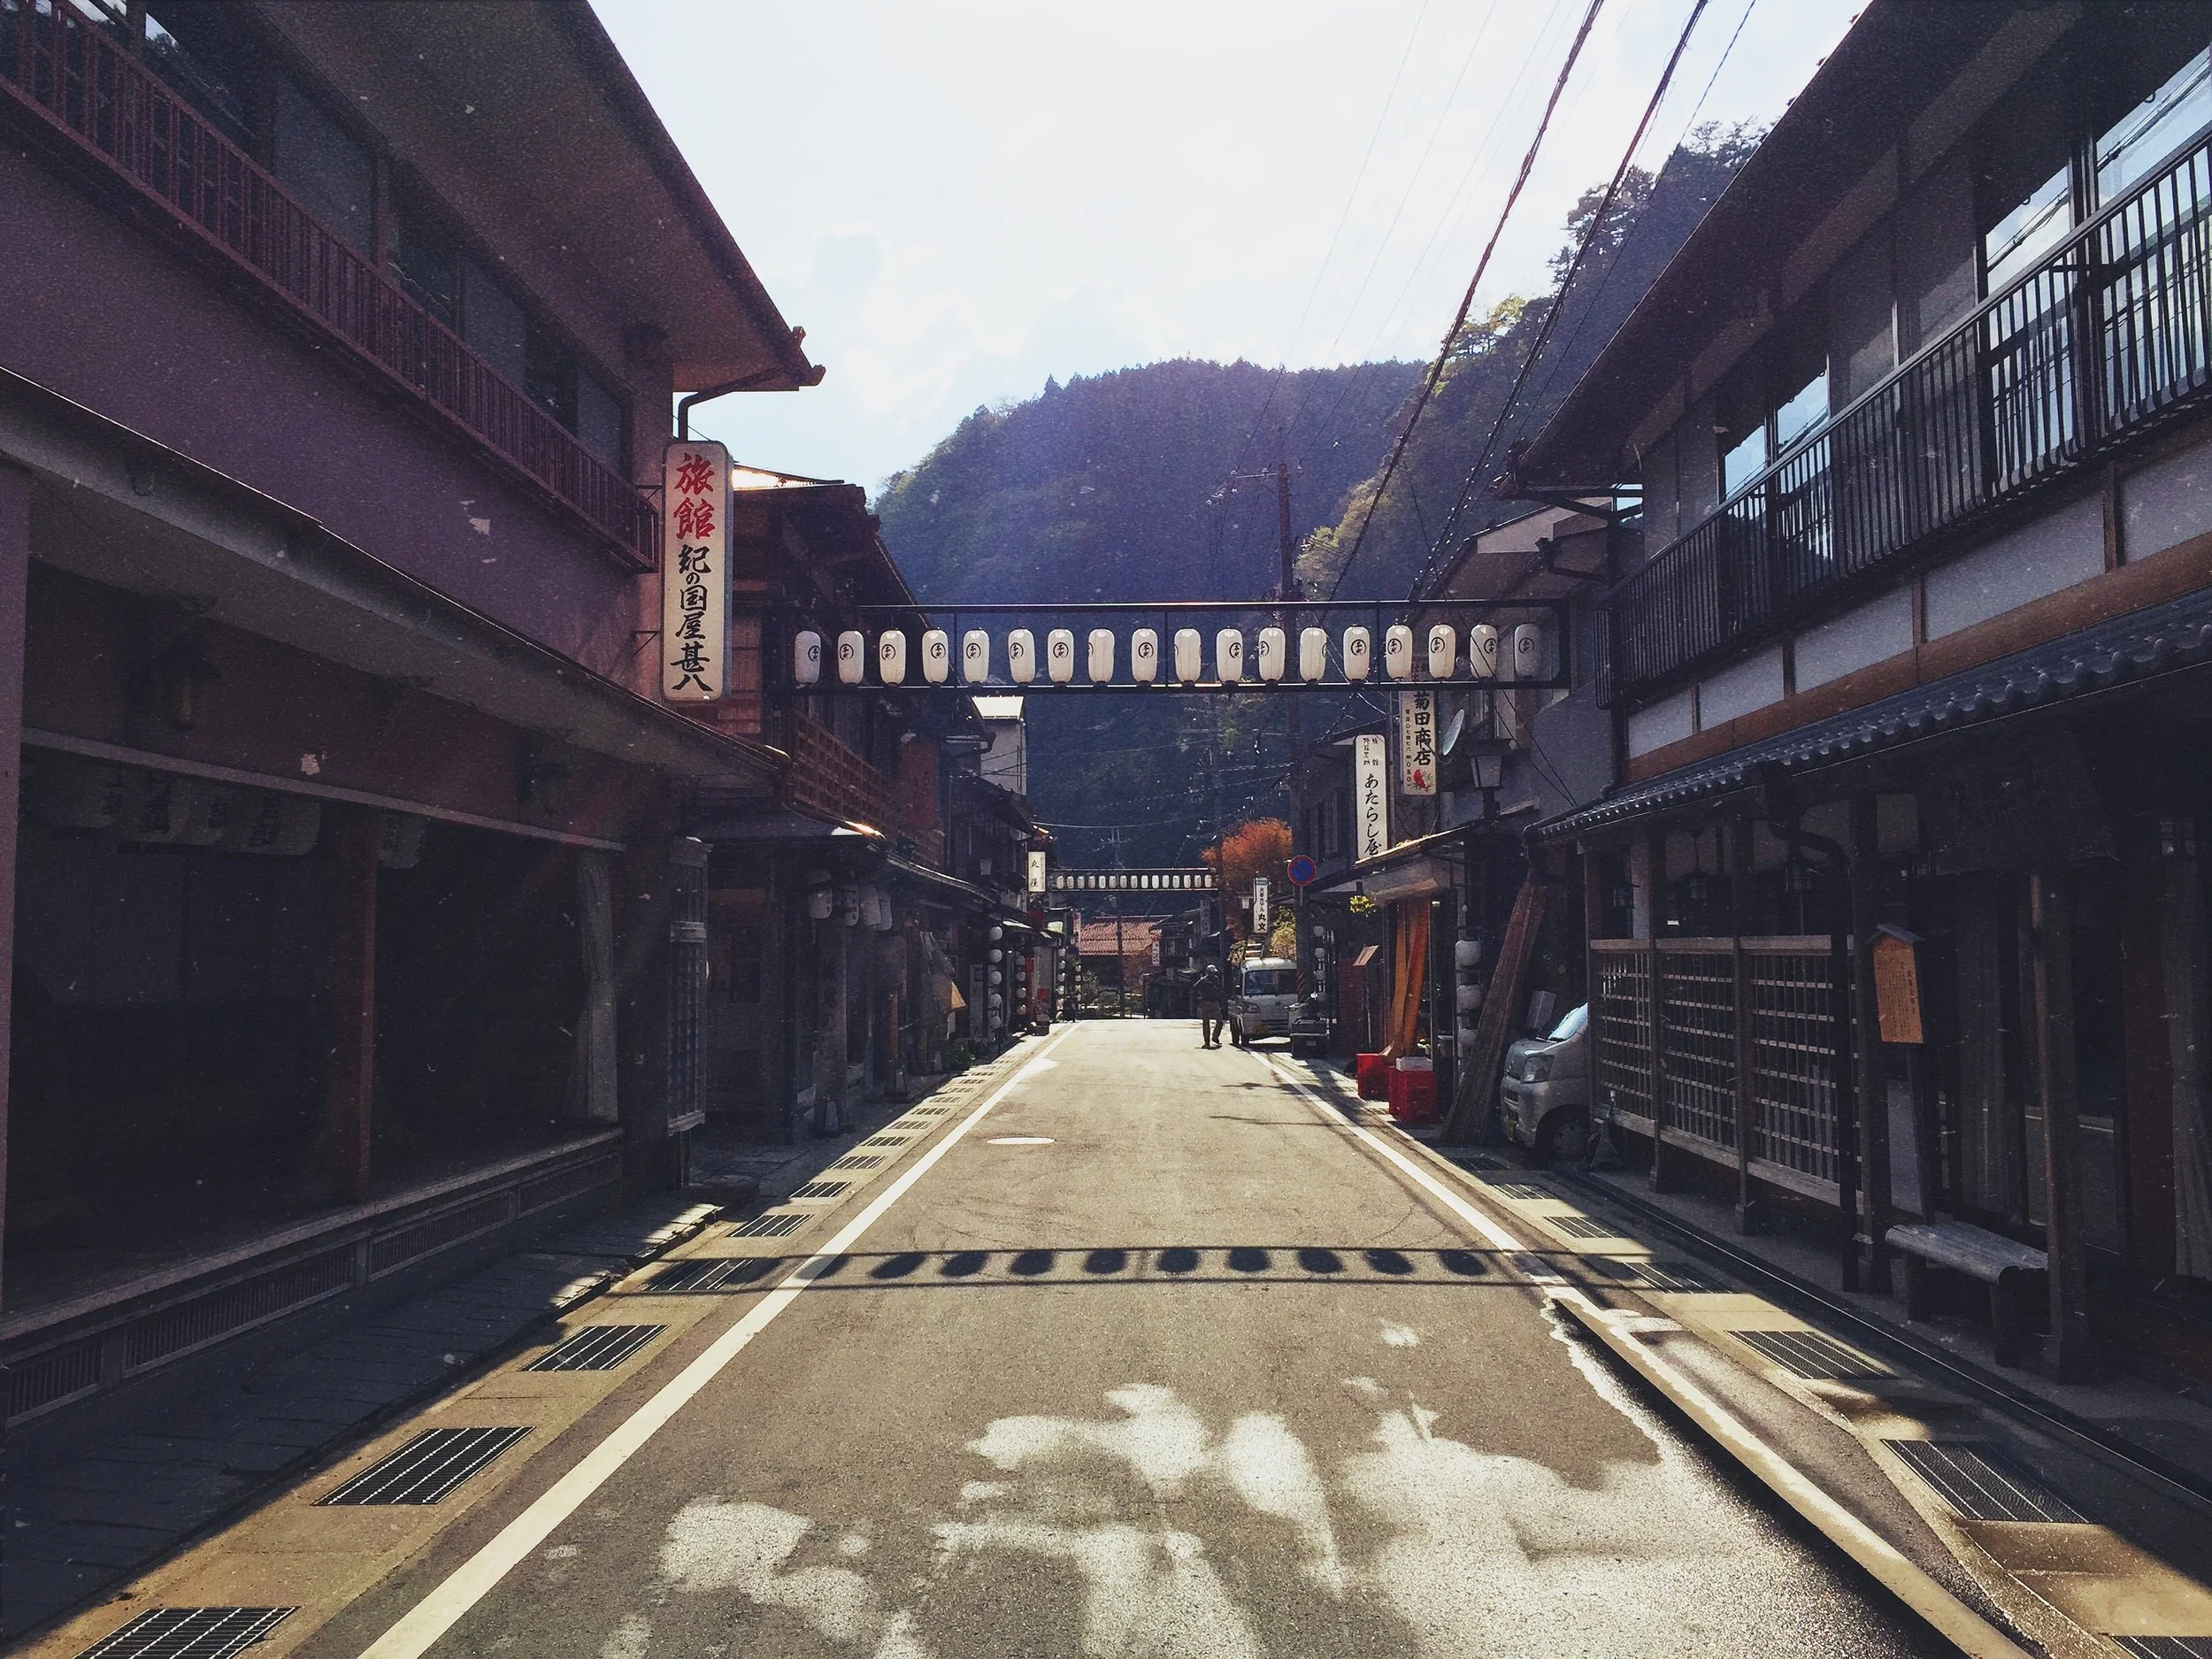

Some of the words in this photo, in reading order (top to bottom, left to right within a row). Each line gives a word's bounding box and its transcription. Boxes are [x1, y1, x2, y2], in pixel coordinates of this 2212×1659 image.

[673, 453, 715, 540] 旅館
[671, 544, 713, 692] 紀の国屋甚八
[1413, 692, 1432, 766] 菊田商店
[1364, 772, 1382, 856] あたらし屋
